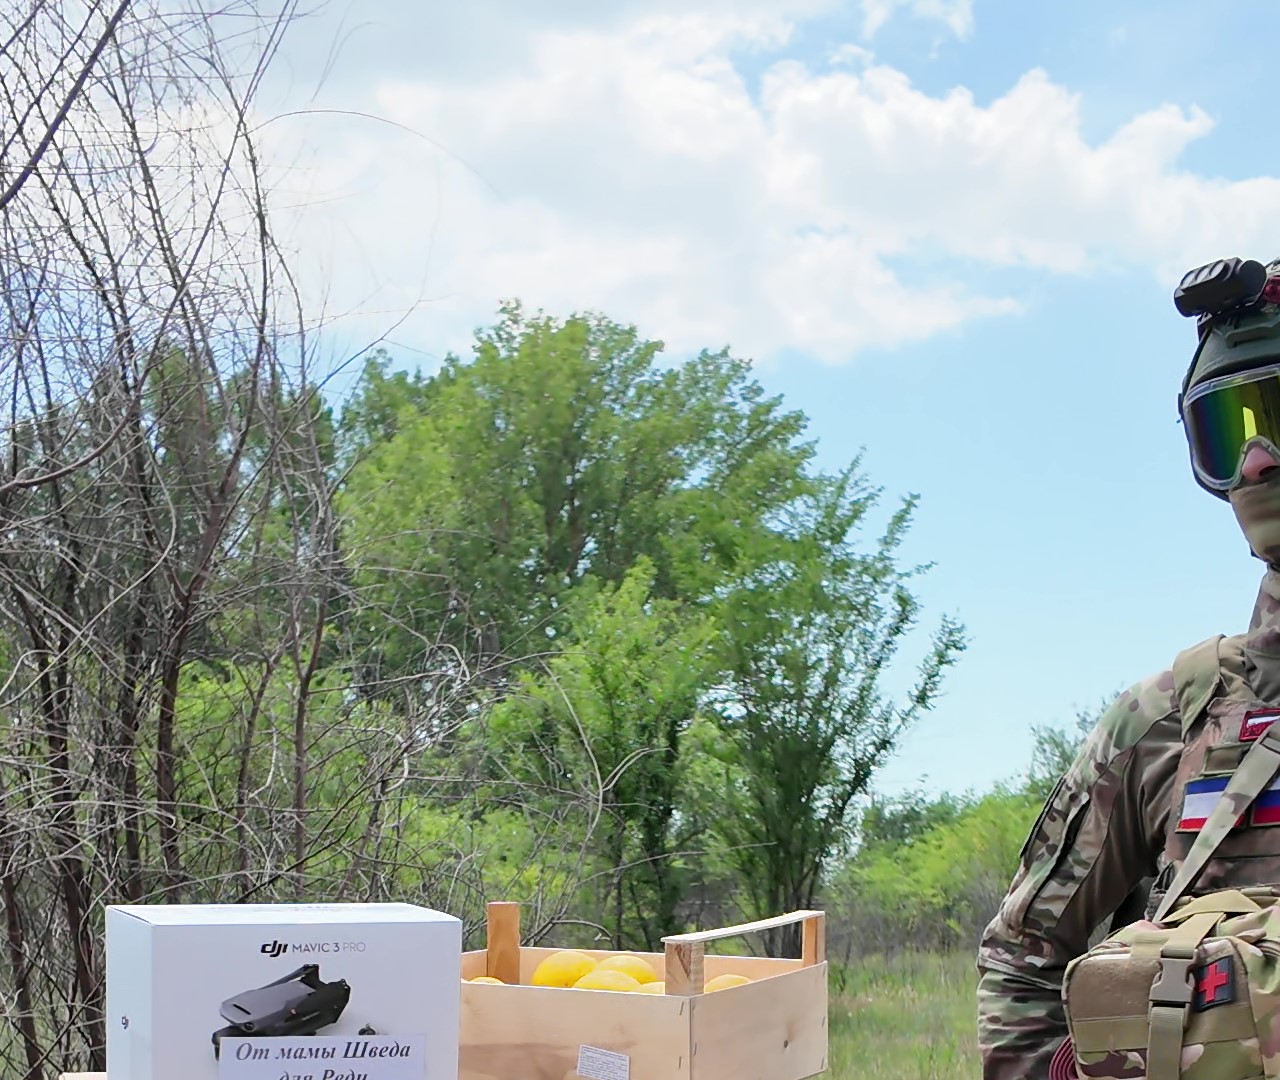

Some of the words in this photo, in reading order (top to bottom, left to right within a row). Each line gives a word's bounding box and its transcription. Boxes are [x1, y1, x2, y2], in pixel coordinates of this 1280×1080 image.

[292, 943, 330, 953] MAVIC
[333, 942, 340, 953] 3
[343, 941, 366, 952] PRO
[236, 1041, 271, 1061] От
[275, 1044, 336, 1060] мамы
[342, 1041, 411, 1060] Шведа
